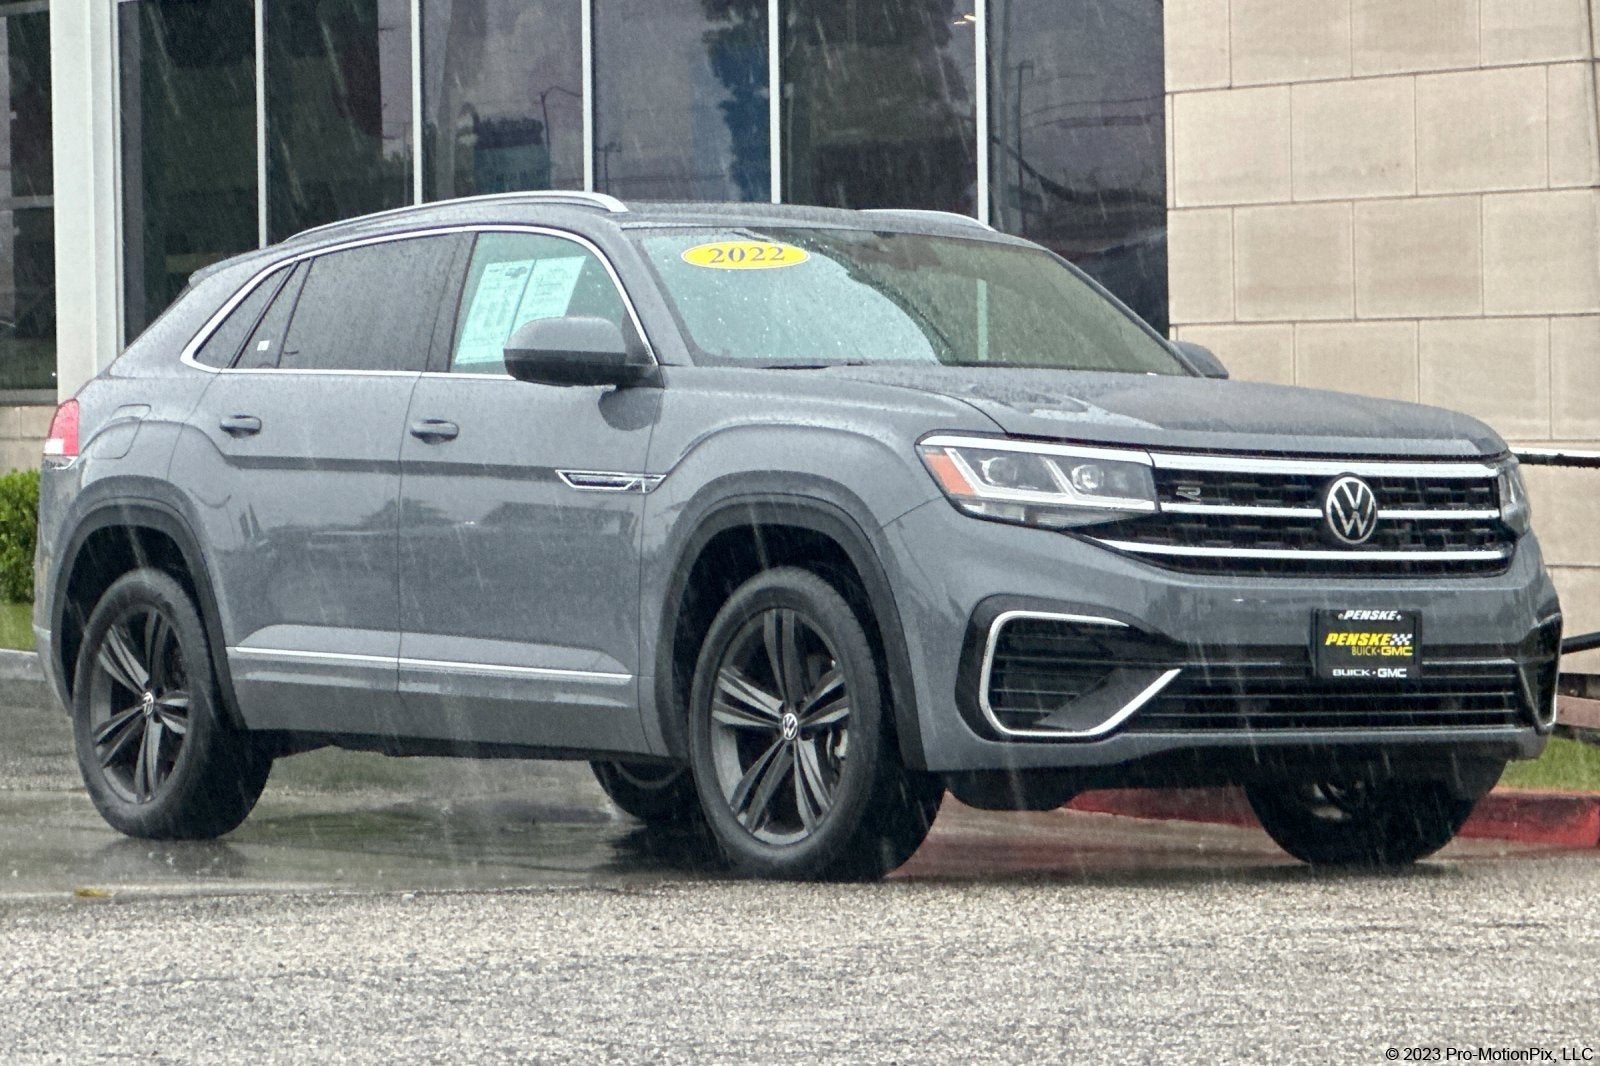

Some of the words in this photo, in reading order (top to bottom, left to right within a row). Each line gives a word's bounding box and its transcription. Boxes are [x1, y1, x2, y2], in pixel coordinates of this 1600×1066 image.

[708, 246, 785, 264] 2022
[1344, 610, 1398, 620] PENSKE
[1325, 633, 1391, 645] PENSKE
[1352, 646, 1377, 656] BUICK
[1381, 646, 1413, 656] GMC
[1378, 668, 1407, 678] GMC
